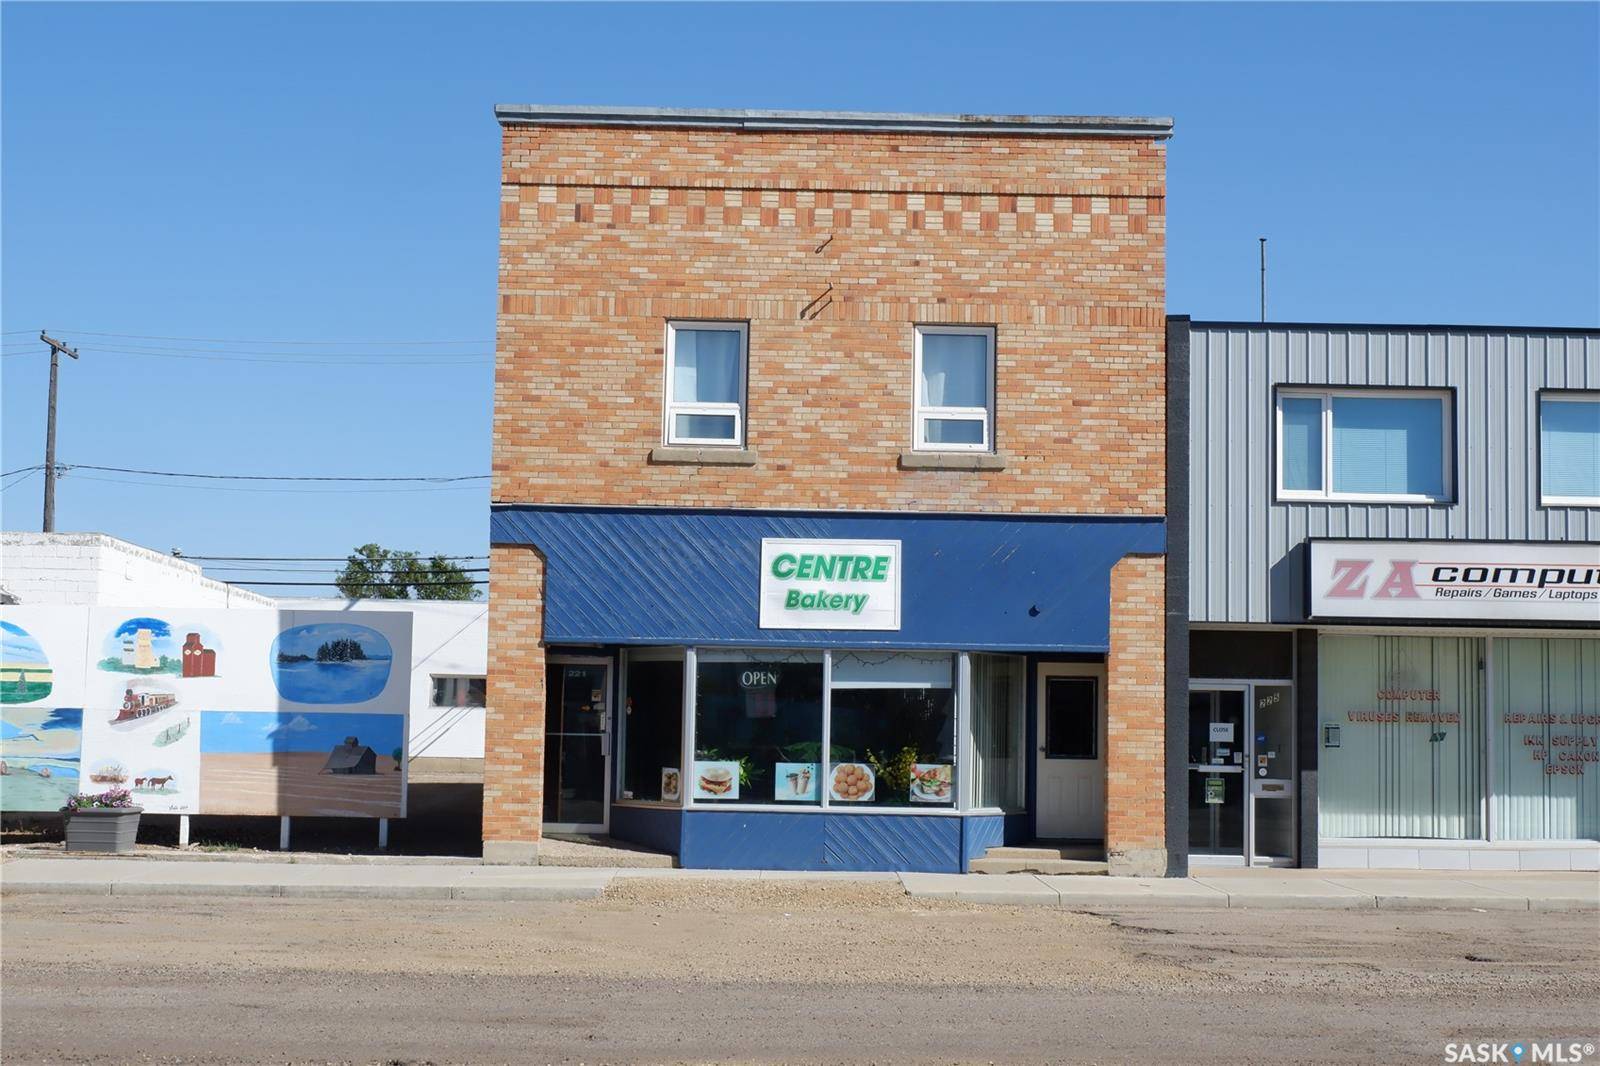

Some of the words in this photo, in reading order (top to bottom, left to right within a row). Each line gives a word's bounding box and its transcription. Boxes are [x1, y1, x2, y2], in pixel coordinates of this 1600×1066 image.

[771, 553, 889, 581] CENTRE
[1325, 559, 1421, 599] ZA
[785, 588, 869, 614] Bakery
[742, 671, 777, 686] OPEN
[1377, 689, 1440, 701] COMPUTER
[1348, 711, 1399, 722] VIRUSES
[1405, 711, 1460, 723] REMOVED
[1504, 713, 1556, 724] REPAIRS
[1551, 736, 1597, 747] SUPPLY
[1558, 751, 1600, 762] CANON
